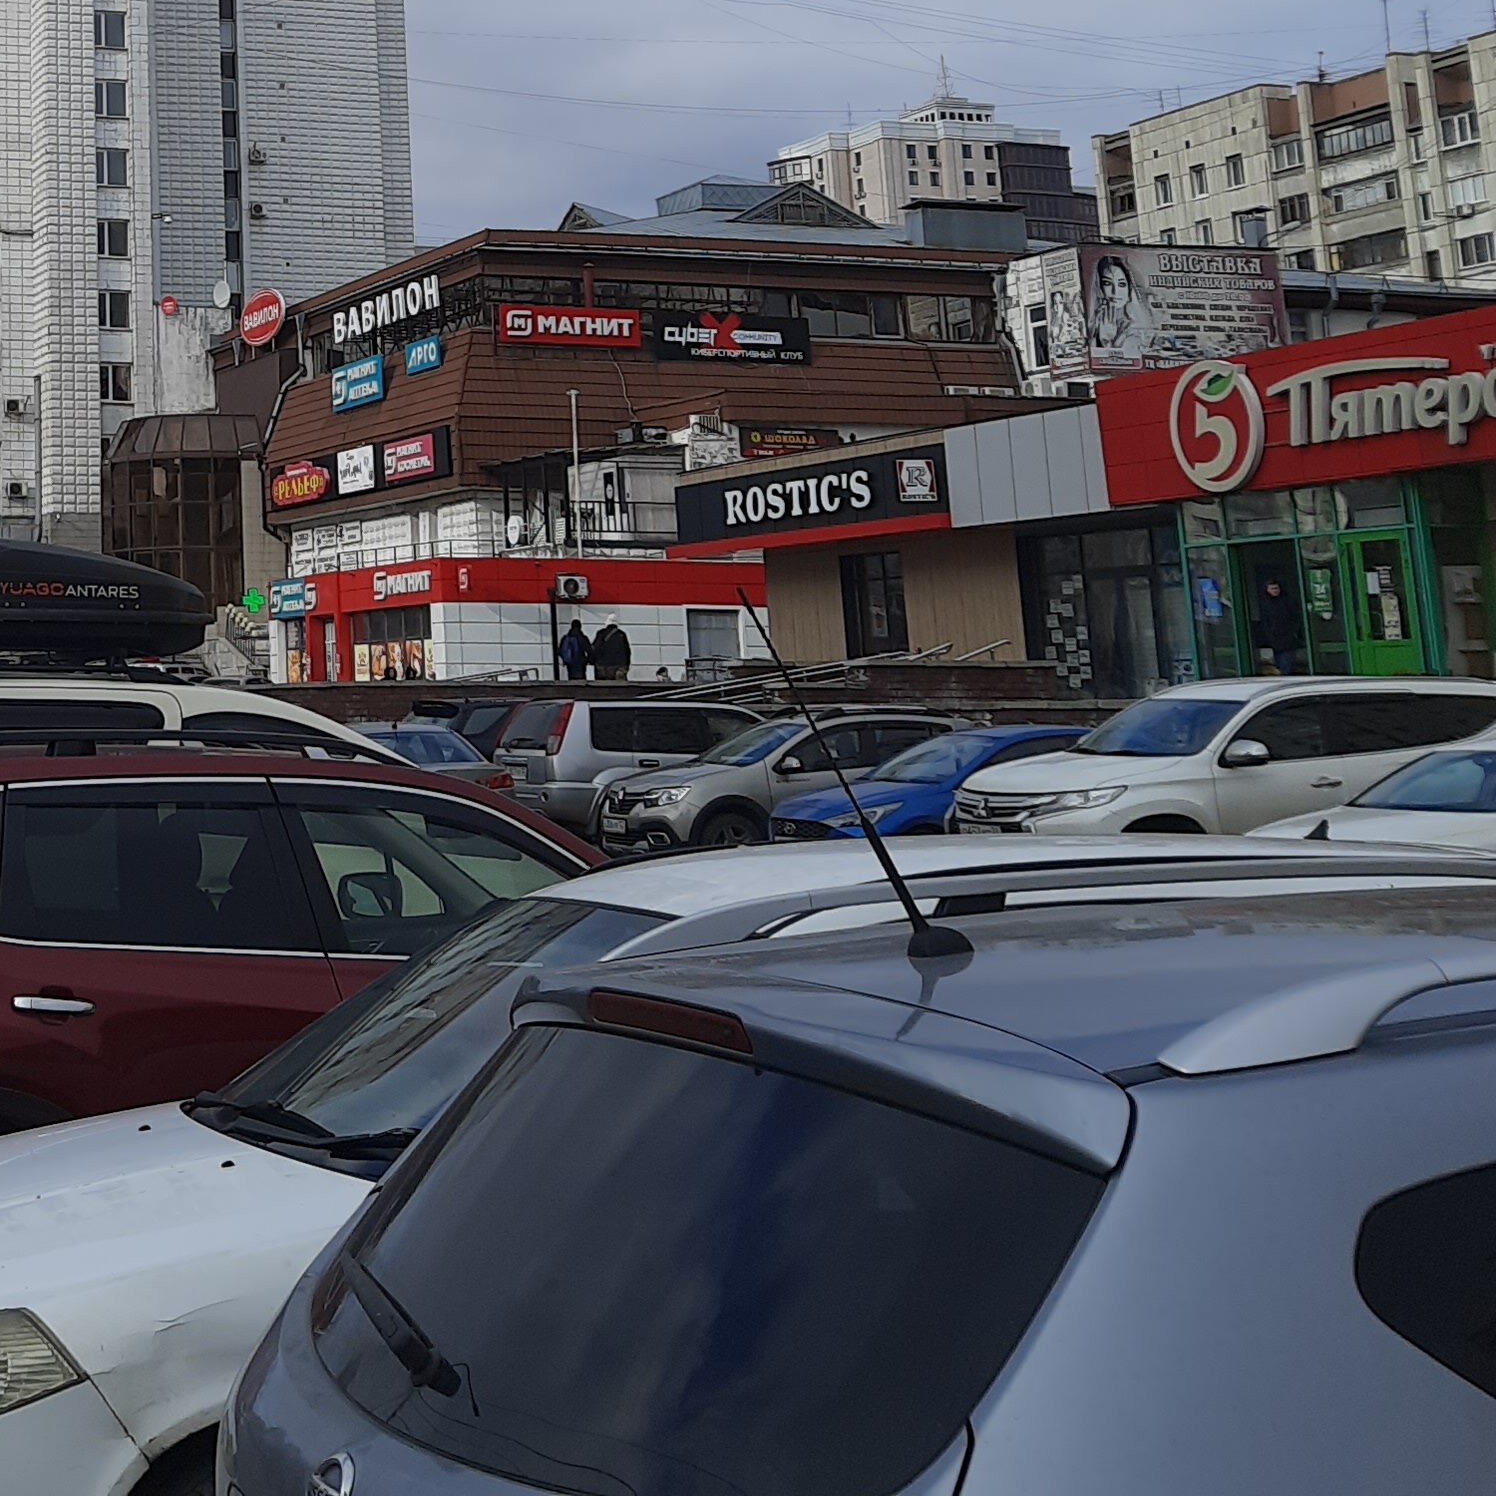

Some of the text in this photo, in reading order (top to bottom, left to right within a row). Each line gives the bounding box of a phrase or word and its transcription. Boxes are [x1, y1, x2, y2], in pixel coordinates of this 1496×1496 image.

[1159, 254, 1262, 275] ВЫСТАВКА
[1225, 277, 1276, 290] ТОВАРОВ
[243, 303, 279, 331] ВАВИЛОН
[332, 274, 441, 344] ВАВИЛОН
[537, 315, 634, 337] МАГНИТ
[407, 344, 437, 369] АРГО
[780, 350, 804, 361] КЛУБ
[724, 470, 872, 525] ROSTIC'S
[387, 569, 432, 596] МАГНИТ
